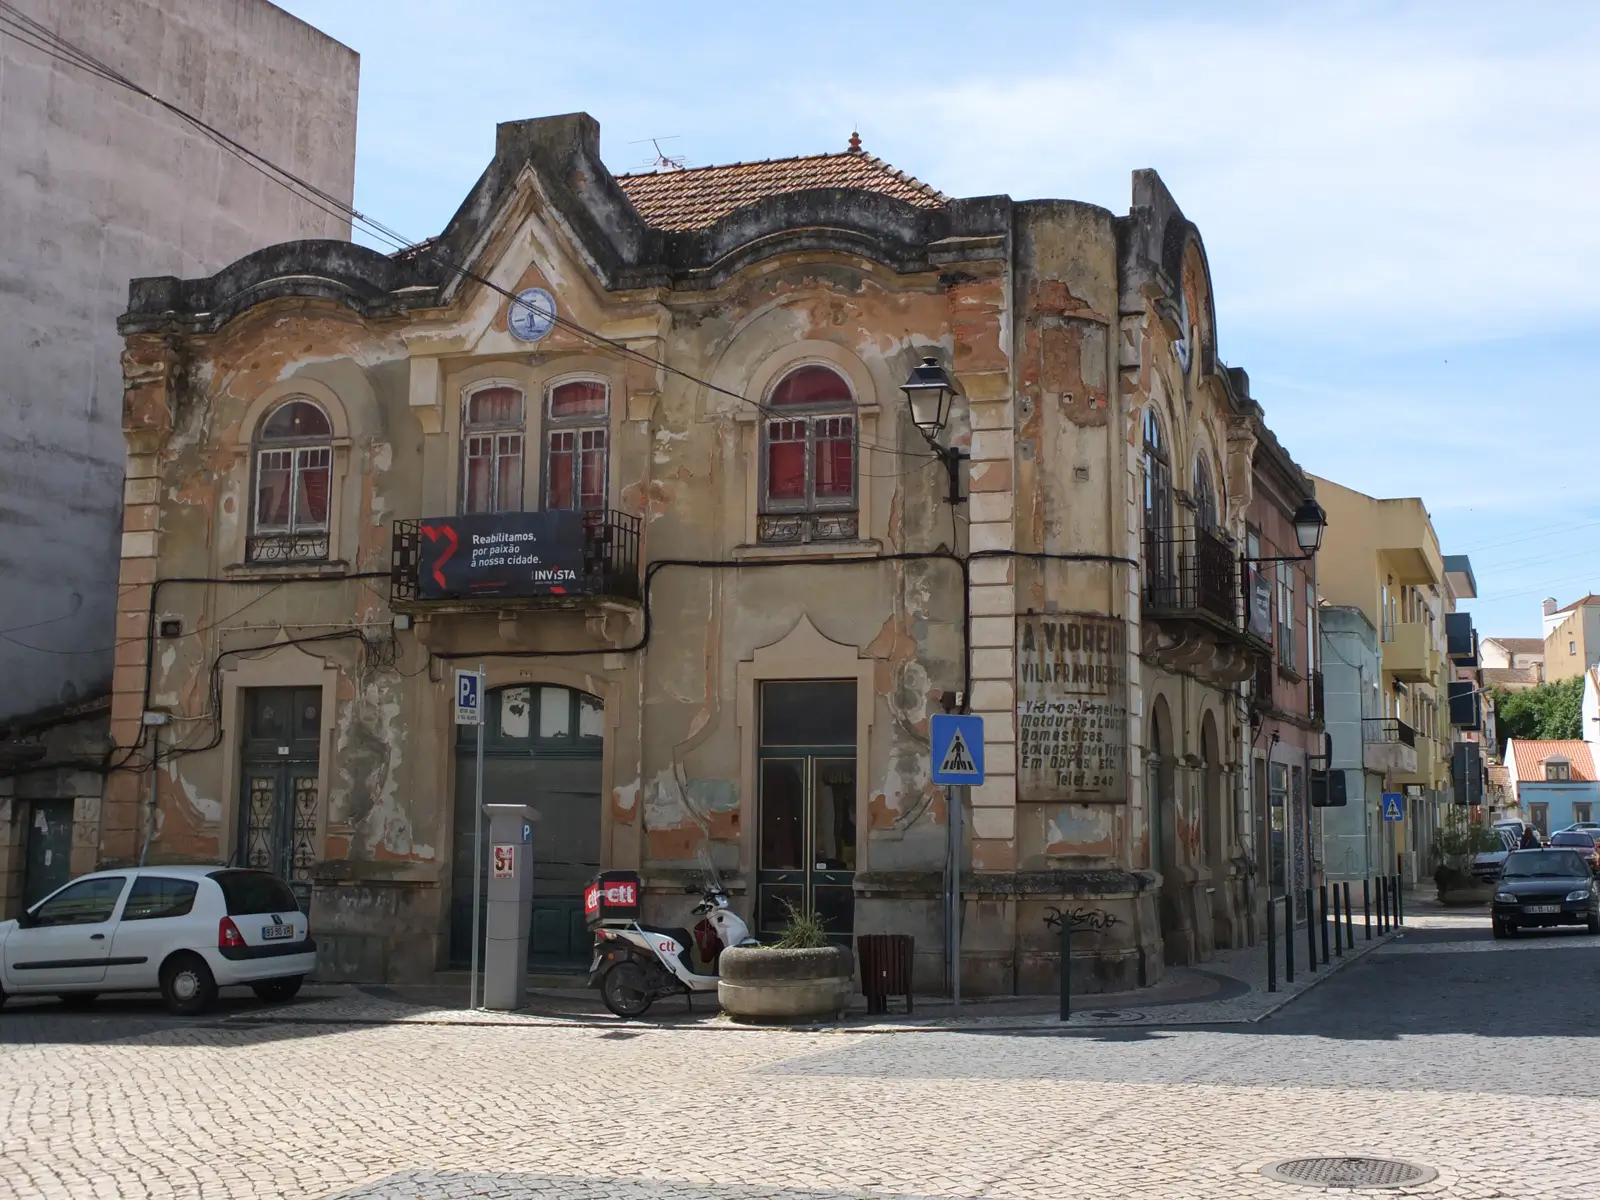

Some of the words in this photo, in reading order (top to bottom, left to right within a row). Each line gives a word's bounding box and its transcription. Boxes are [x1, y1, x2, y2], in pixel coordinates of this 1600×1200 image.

[472, 532, 537, 545] Reabilitamos,
[472, 547, 488, 559] por
[489, 543, 520, 558] paixão
[478, 557, 505, 567] nossa
[507, 554, 542, 565] cidade.
[1021, 622, 1036, 652] A
[460, 677, 471, 705] P
[1021, 756, 1043, 769] Em
[523, 824, 530, 841] P
[607, 885, 634, 903] ctt
[659, 940, 676, 952] ctt
